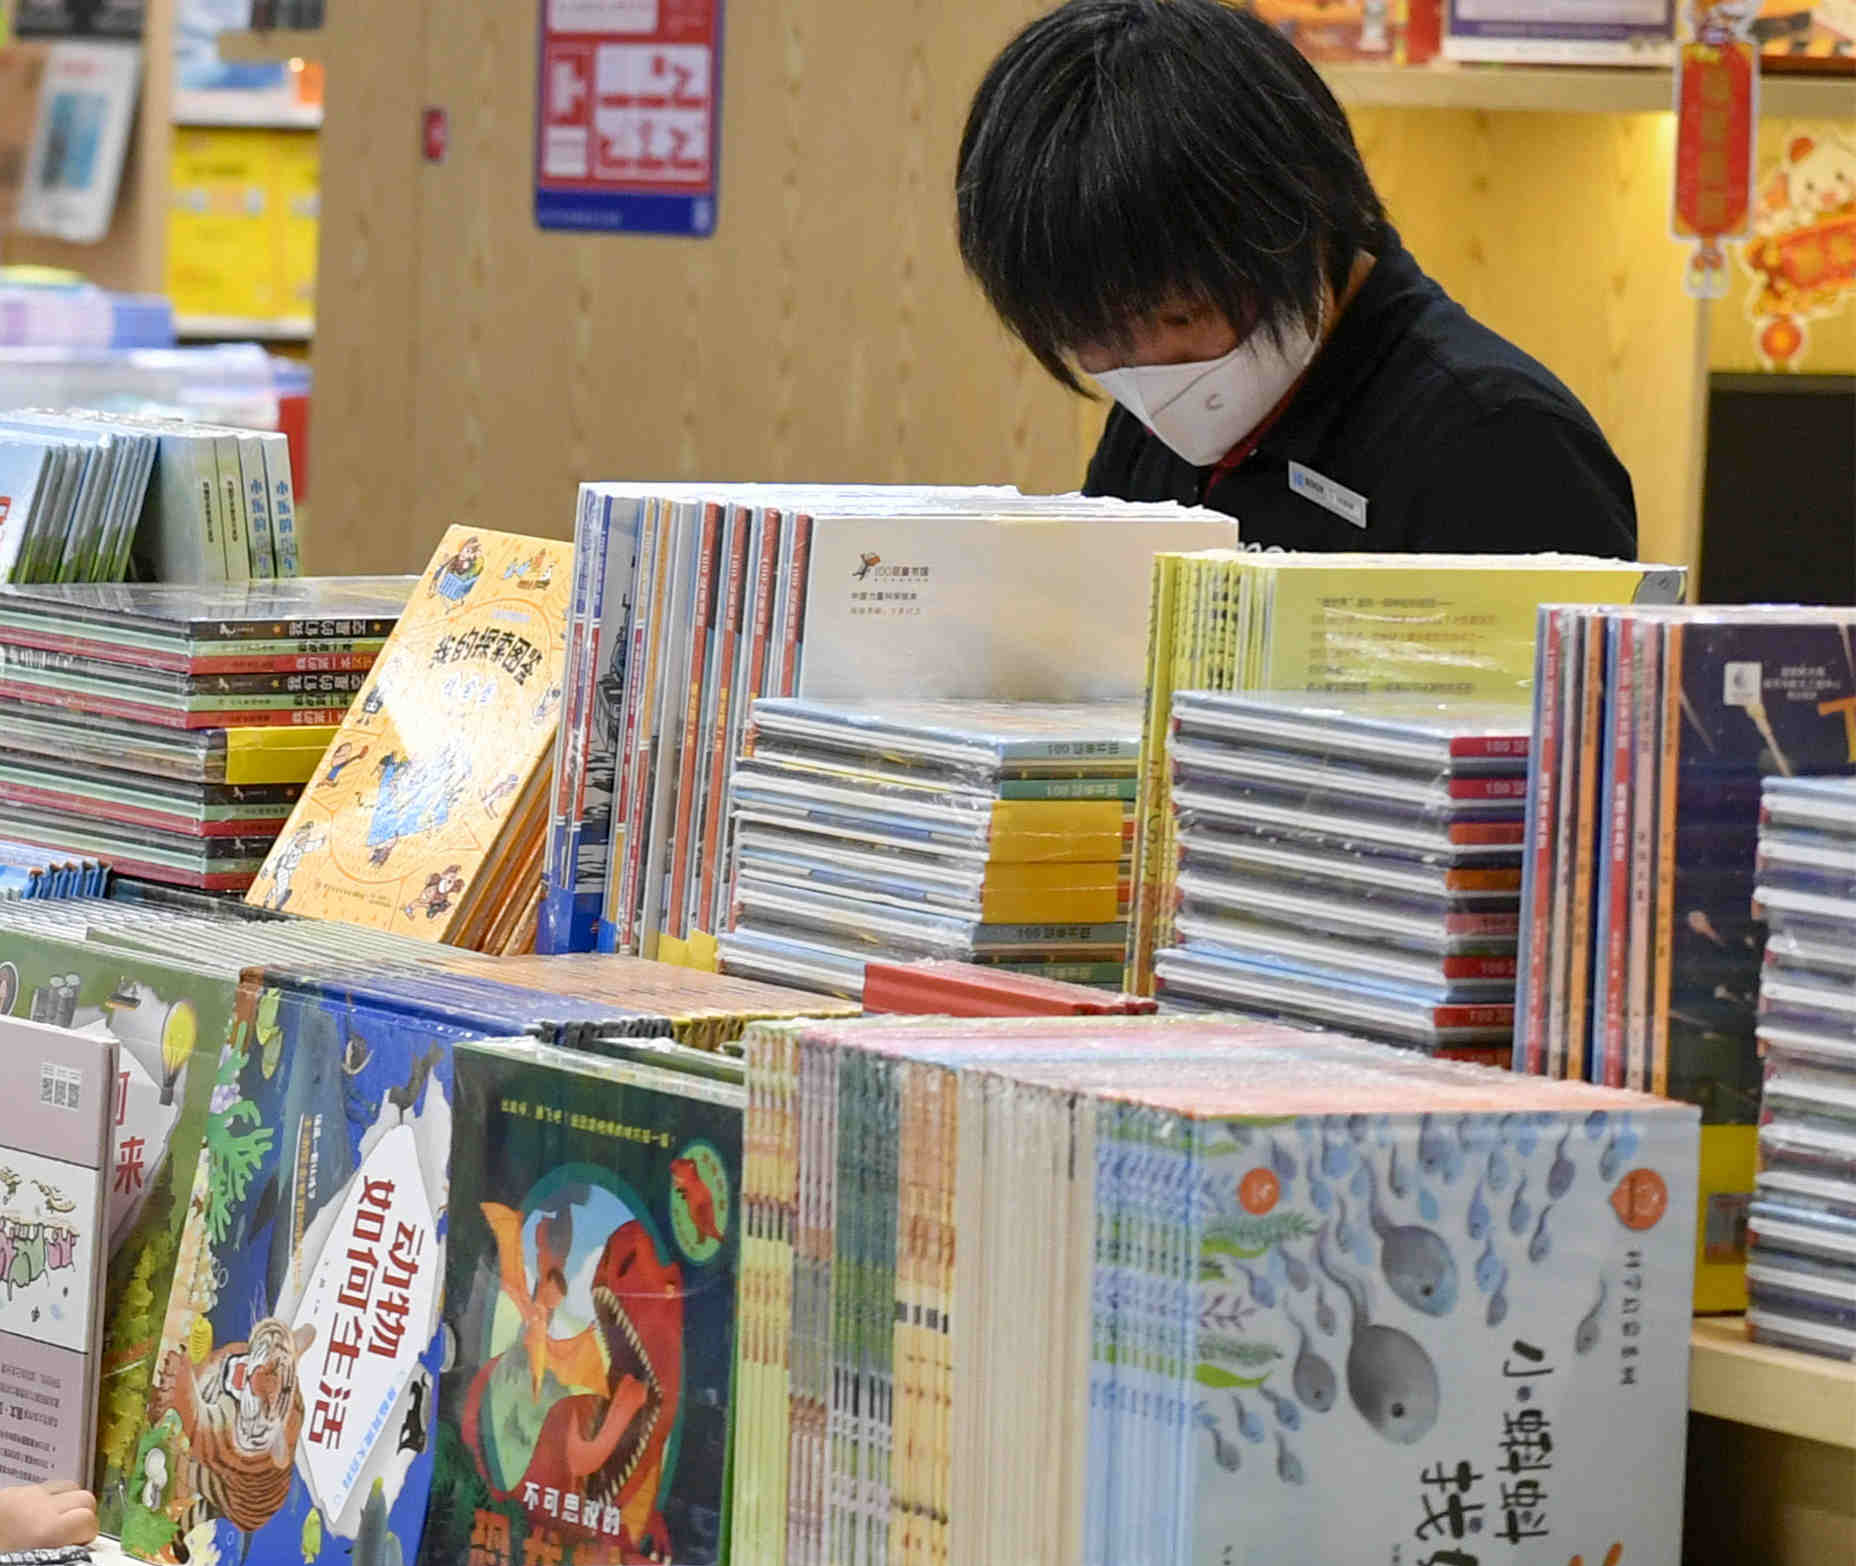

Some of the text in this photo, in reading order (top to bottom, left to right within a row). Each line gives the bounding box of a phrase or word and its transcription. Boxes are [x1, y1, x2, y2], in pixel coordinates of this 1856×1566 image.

[306, 1175, 396, 1450] 如何生活
[368, 1220, 425, 1359] 动物
[522, 1481, 621, 1536] 不可思议的
[1494, 1338, 1555, 1546] 小蝌蚪
